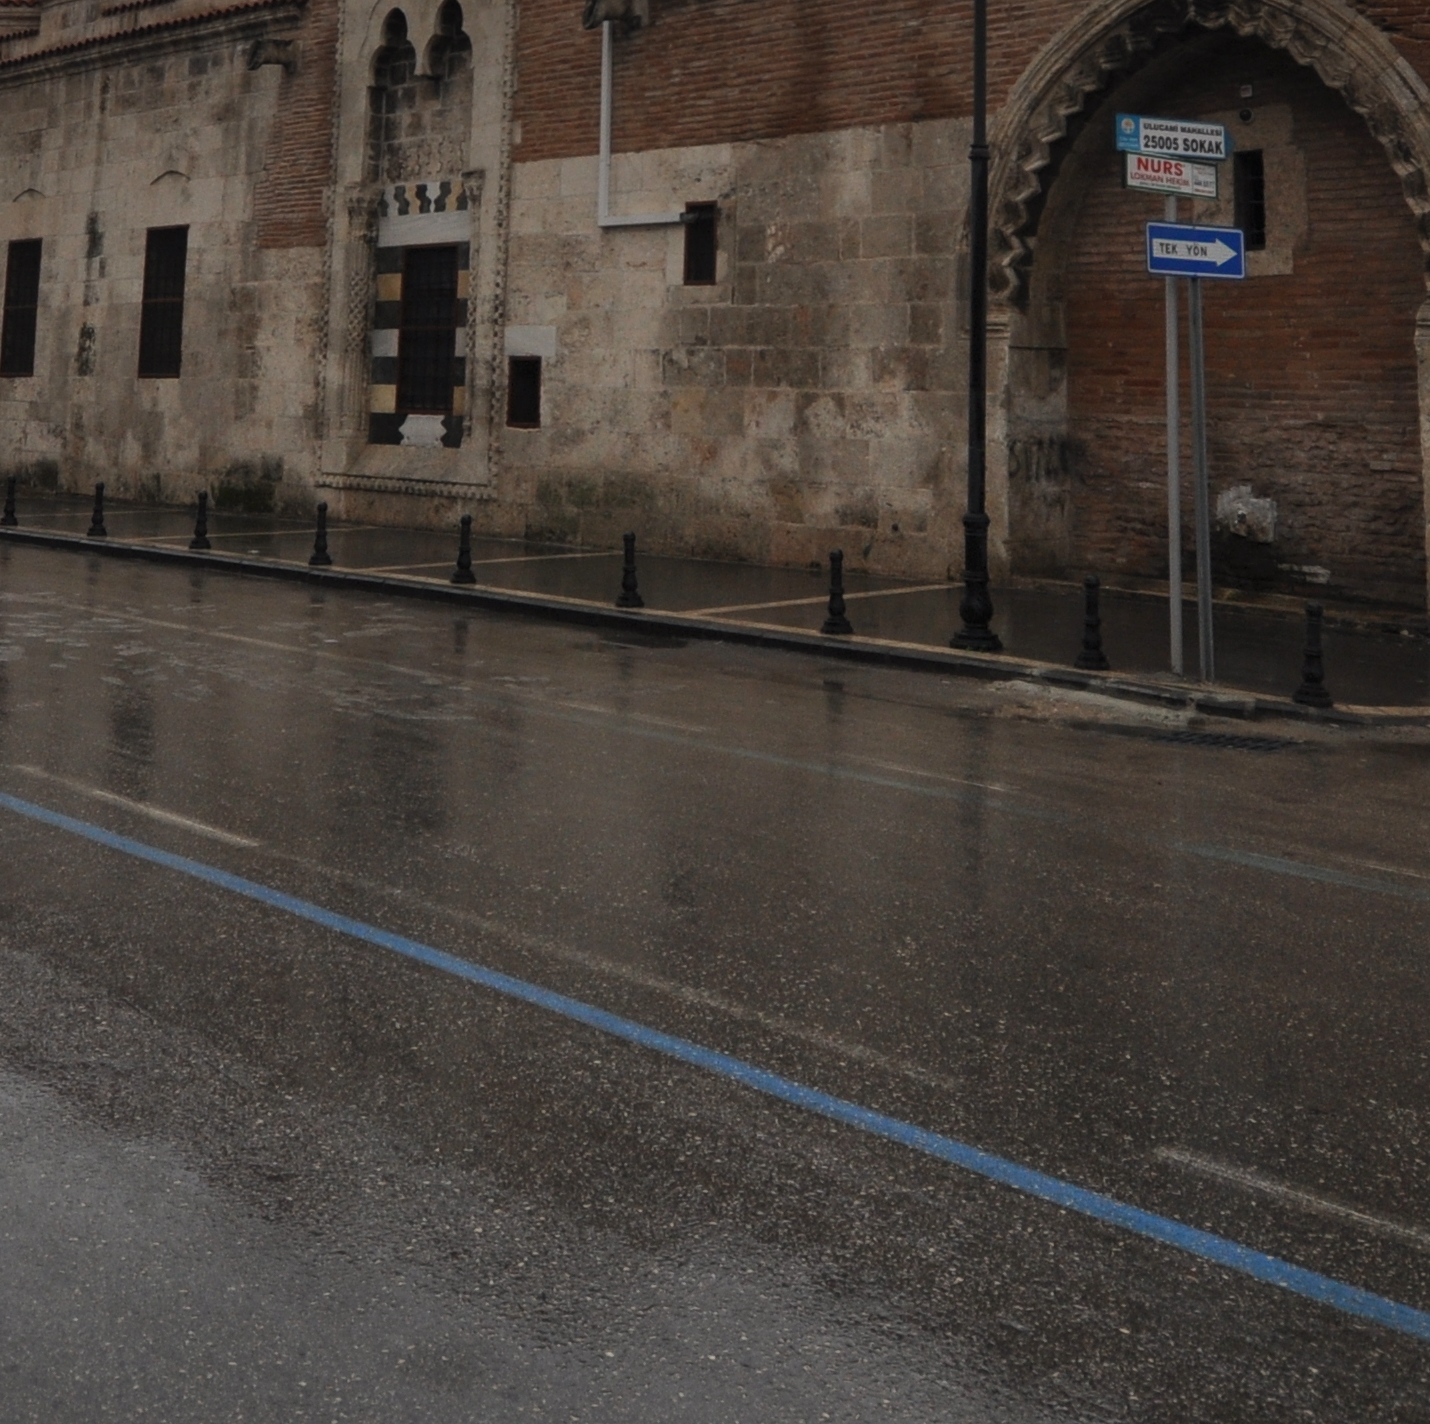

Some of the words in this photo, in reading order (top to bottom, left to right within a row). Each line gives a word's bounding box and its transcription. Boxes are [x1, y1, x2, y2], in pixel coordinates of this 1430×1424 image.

[1143, 135, 1179, 151] 25005
[1183, 138, 1223, 154] SOKAK
[1137, 157, 1183, 176] NURS
[1159, 243, 1177, 254] TEK
[1187, 243, 1207, 256] YÖN
